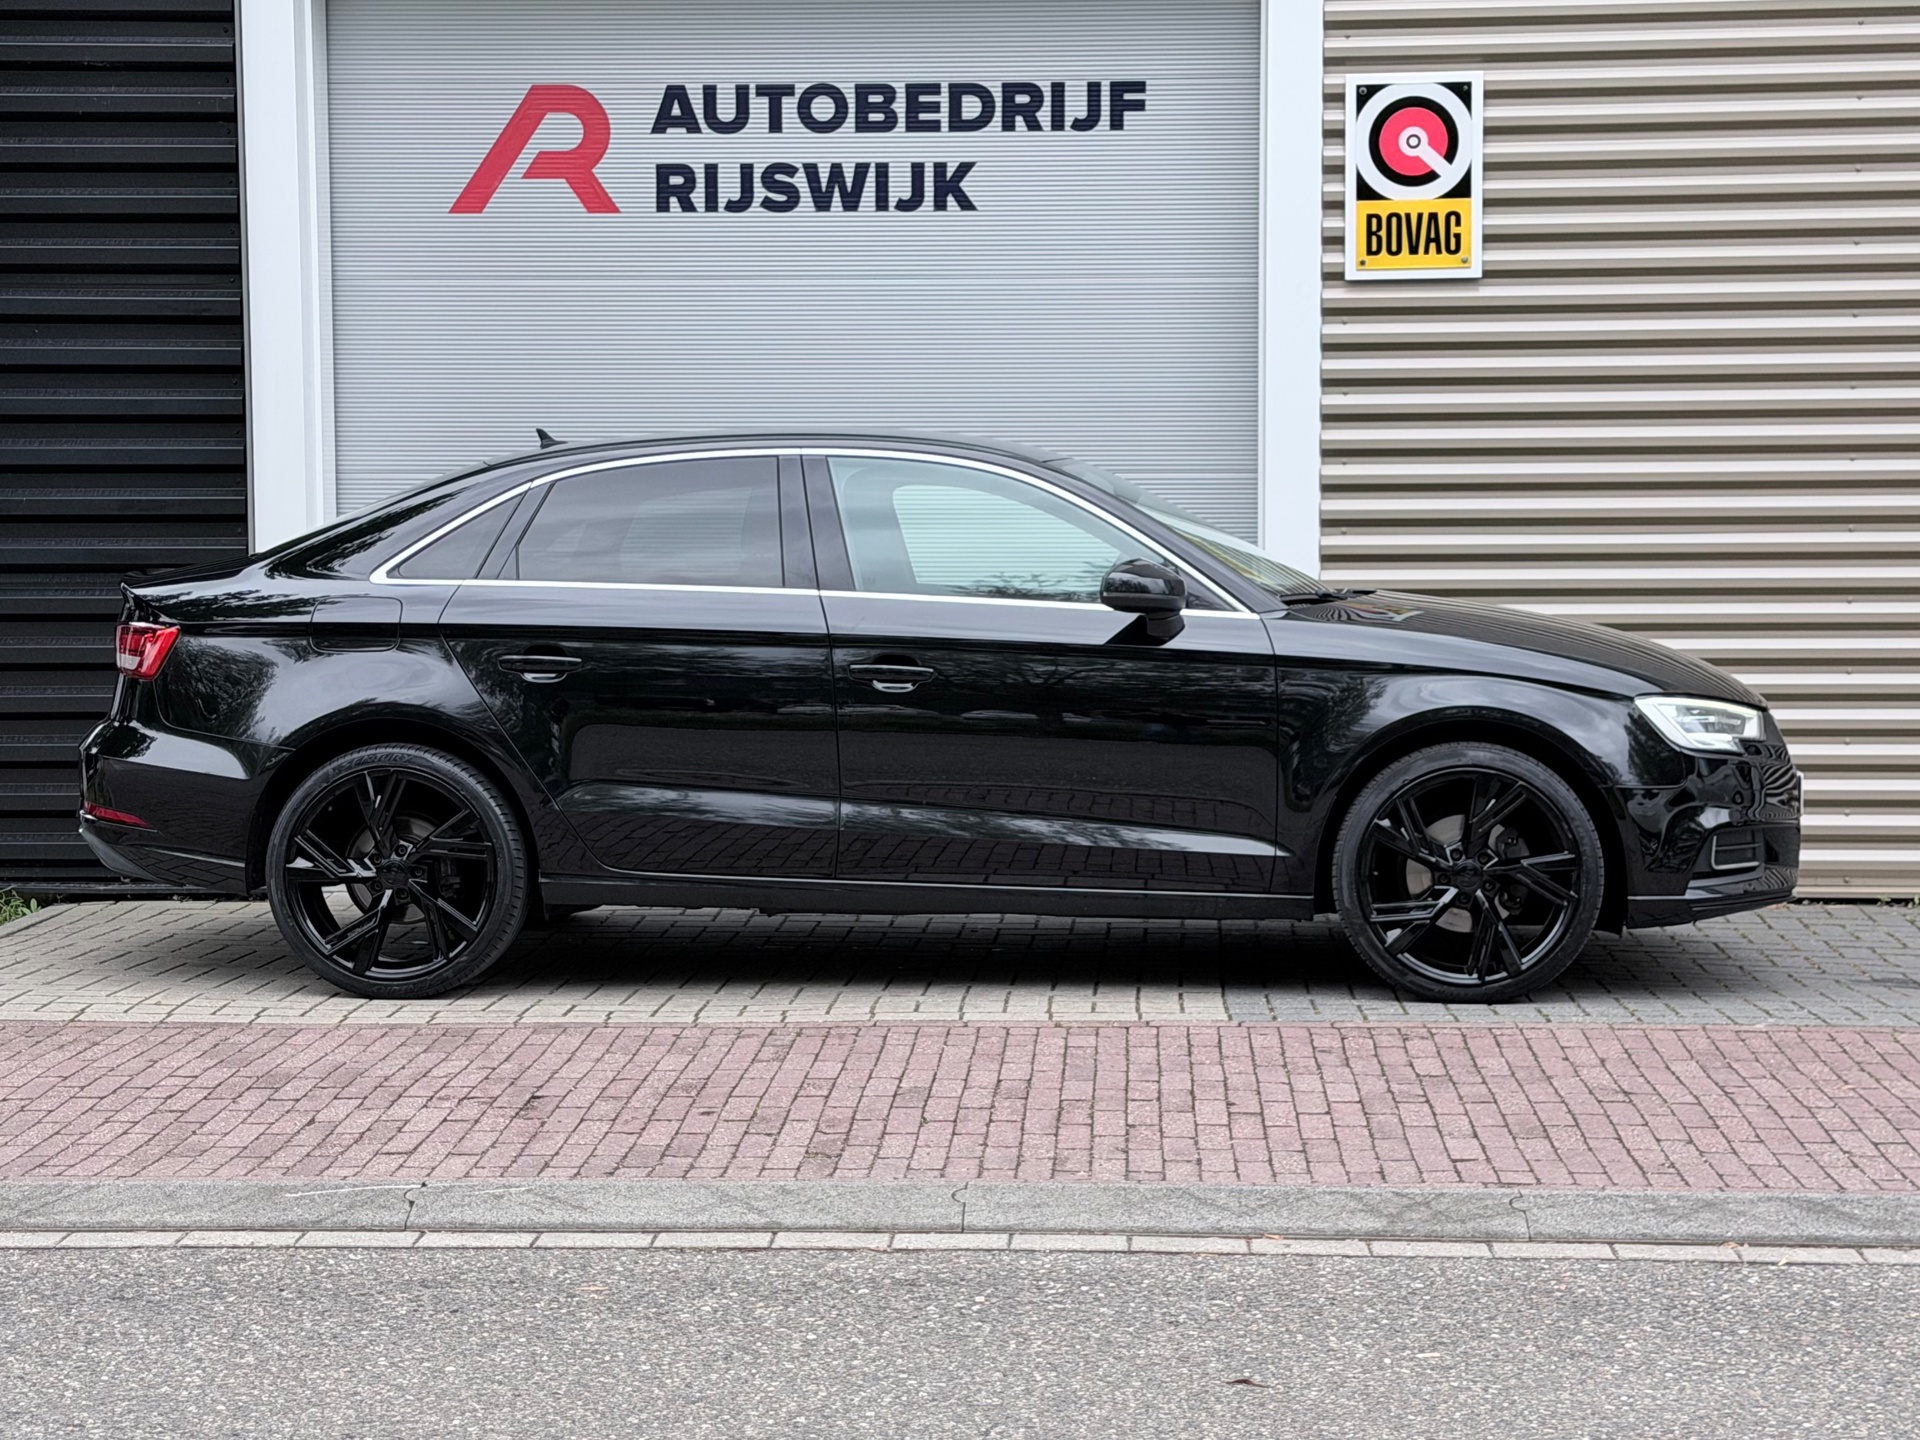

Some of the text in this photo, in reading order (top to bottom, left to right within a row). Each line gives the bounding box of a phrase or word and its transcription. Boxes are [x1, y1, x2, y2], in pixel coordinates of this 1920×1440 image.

[651, 81, 1146, 134] AUTOBEDRIJF
[656, 162, 976, 213] RIJSWIJK
[1367, 211, 1461, 256] BOVAG
